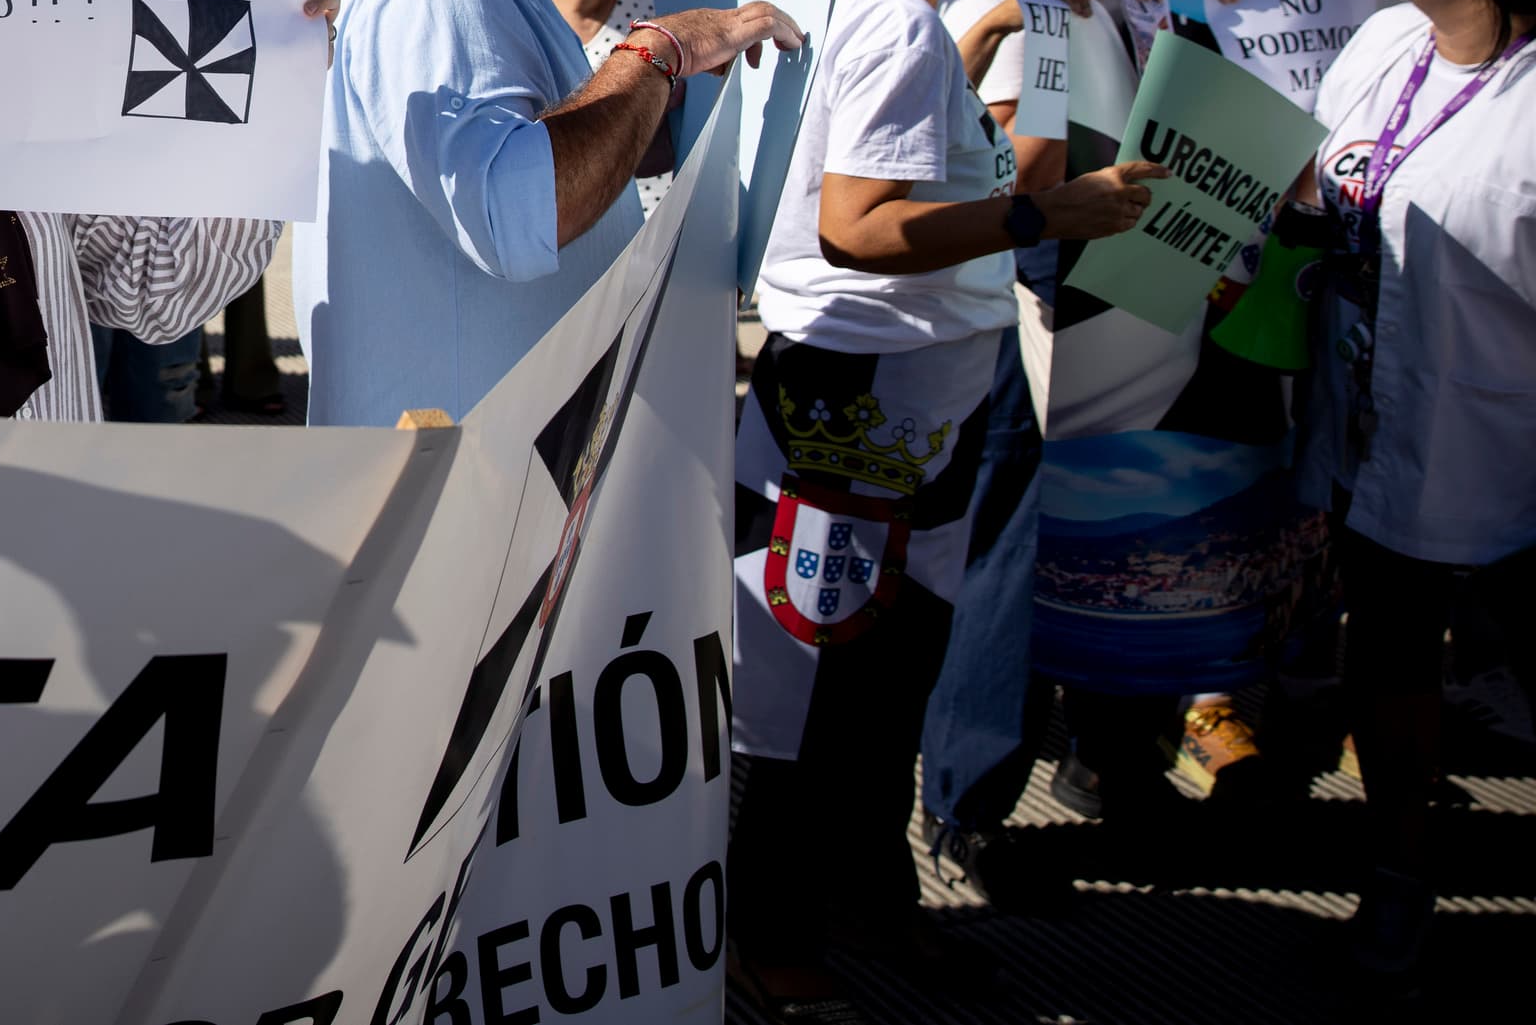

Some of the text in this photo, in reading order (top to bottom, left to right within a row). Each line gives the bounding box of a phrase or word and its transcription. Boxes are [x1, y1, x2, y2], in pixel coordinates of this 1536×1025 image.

[1237, 23, 1360, 59] PODEMO
[1140, 118, 1280, 225] URGENCIAS
[1142, 201, 1231, 267] LÍMITE
